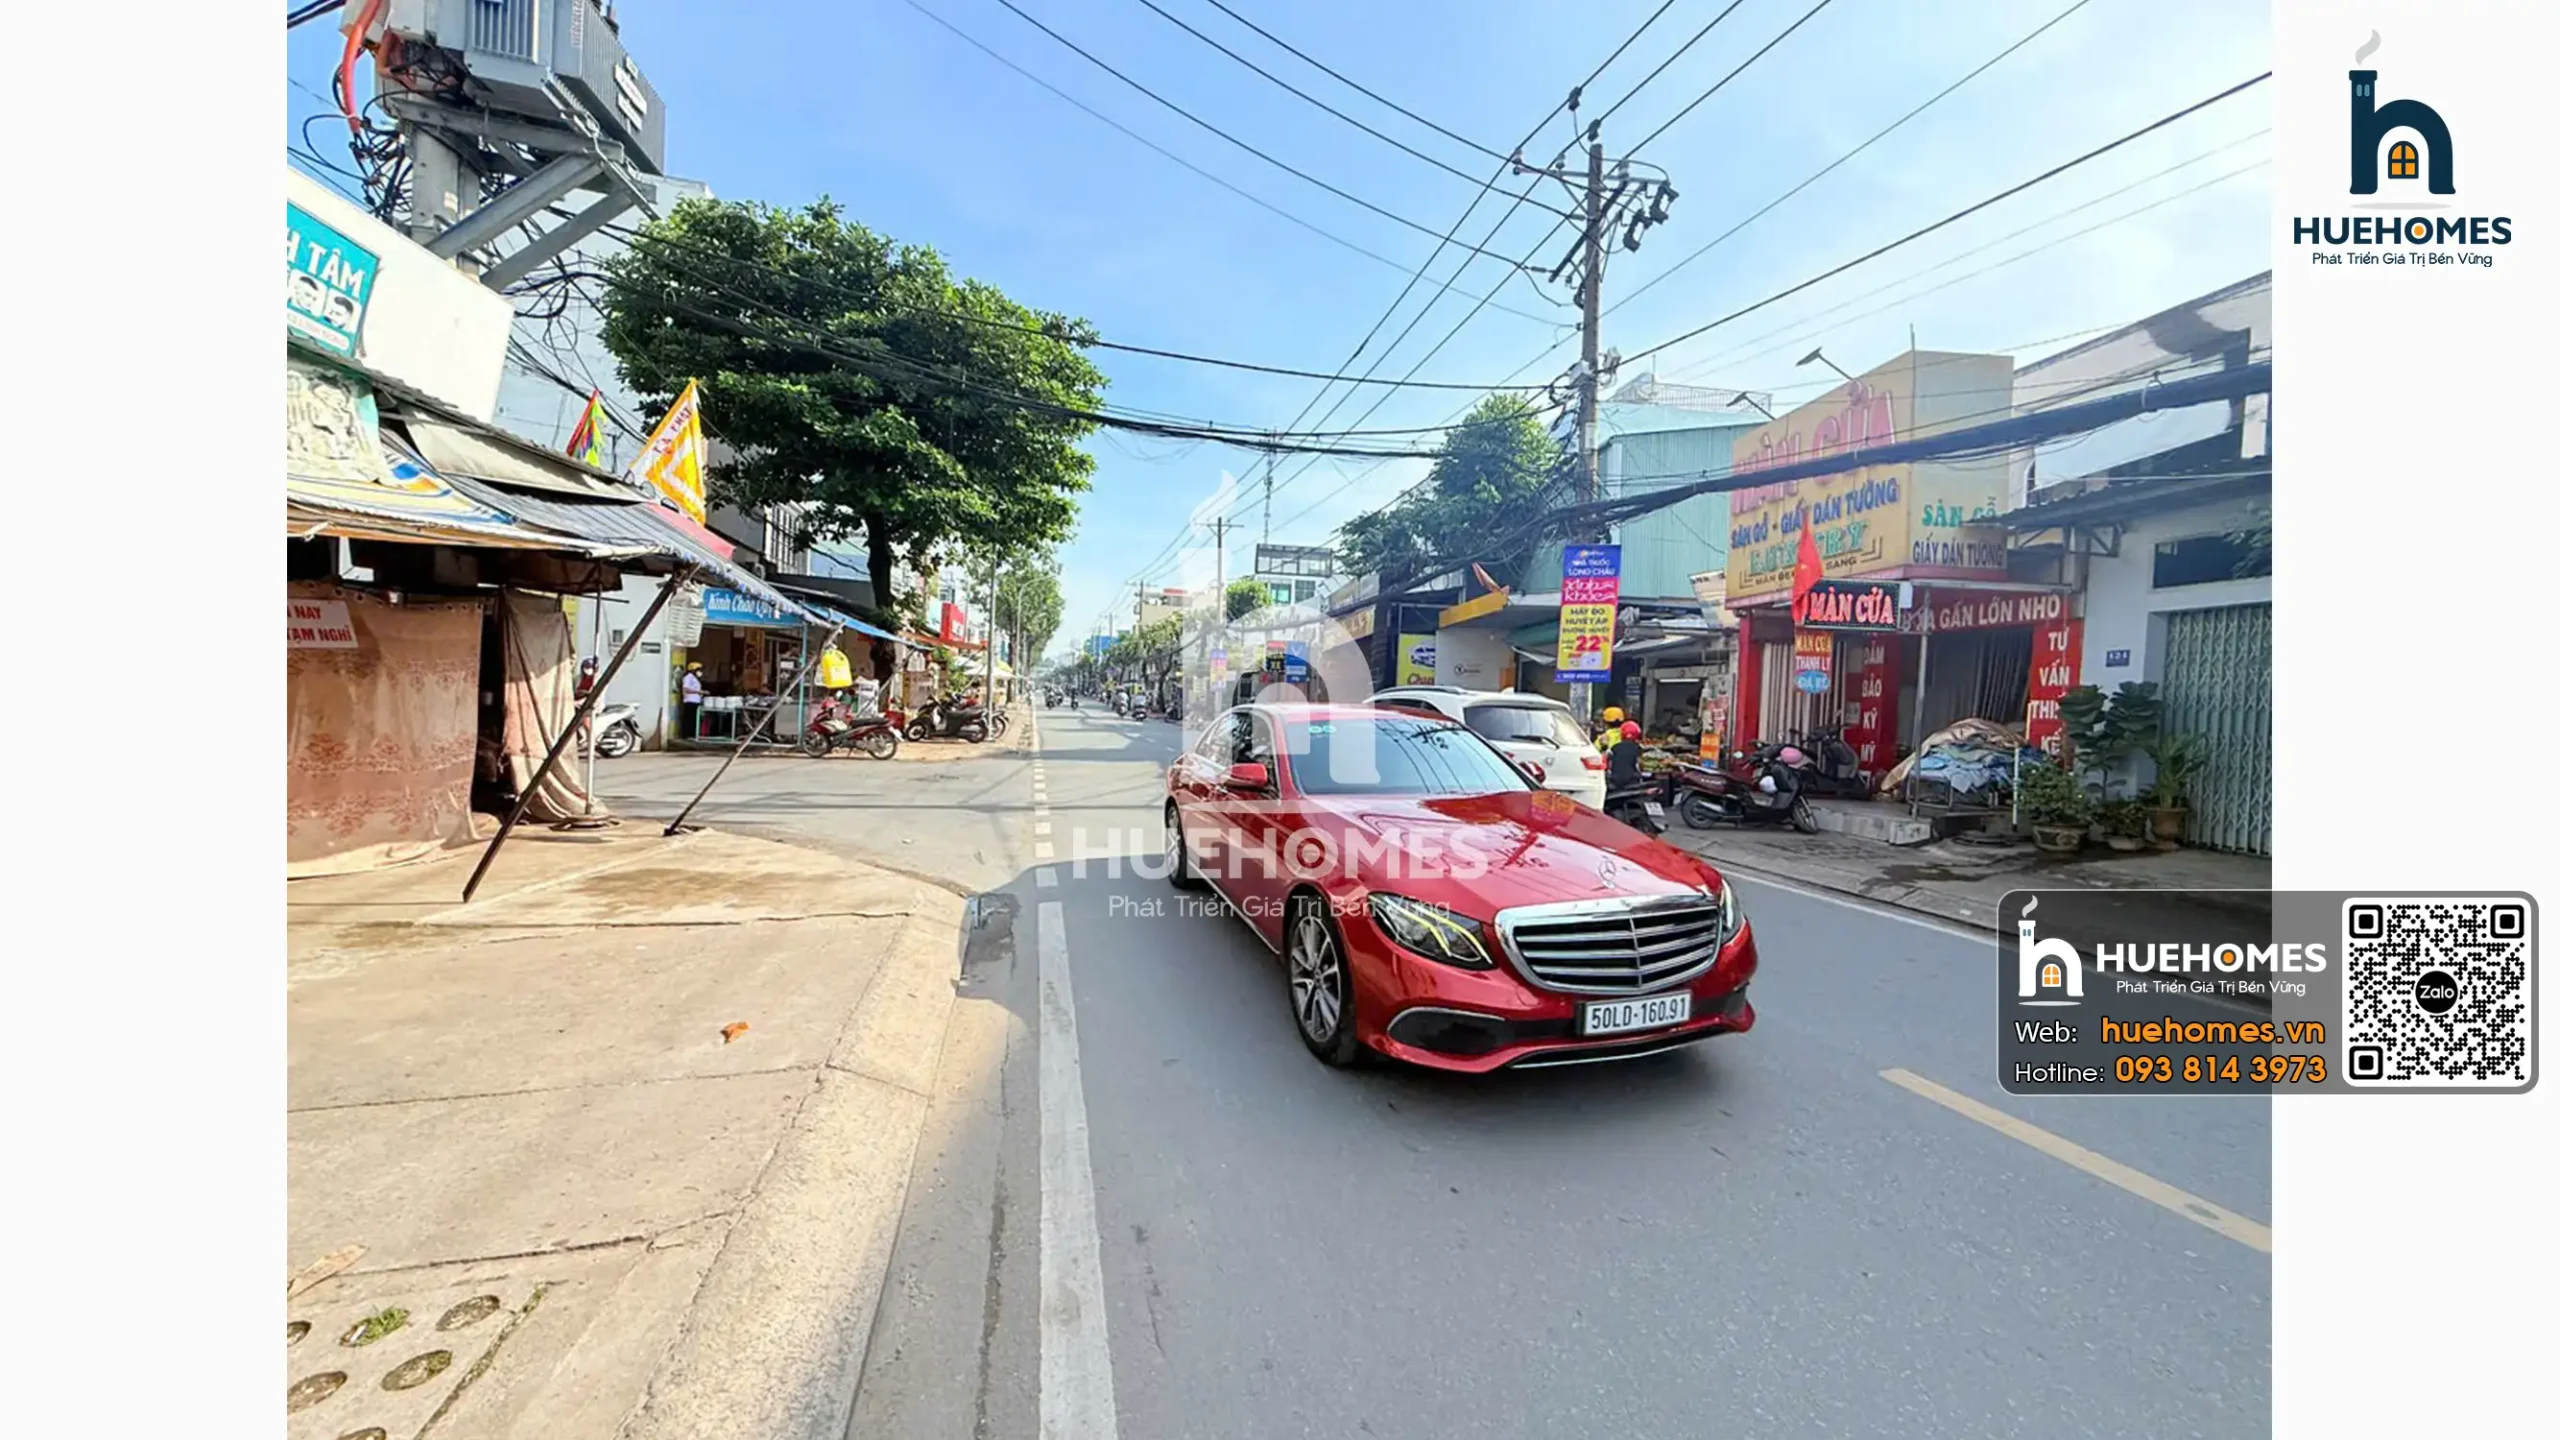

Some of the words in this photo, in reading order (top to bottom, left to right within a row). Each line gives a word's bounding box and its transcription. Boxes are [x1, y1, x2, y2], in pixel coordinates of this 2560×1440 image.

[308, 241, 366, 300] TÂM
[1912, 532, 1939, 564] GIẤY
[294, 607, 321, 619] NAY
[1855, 586, 1895, 624] CỬA
[319, 625, 352, 641] NGHỈ
[1862, 673, 1883, 698] BẢO
[2039, 658, 2070, 687] VẤN
